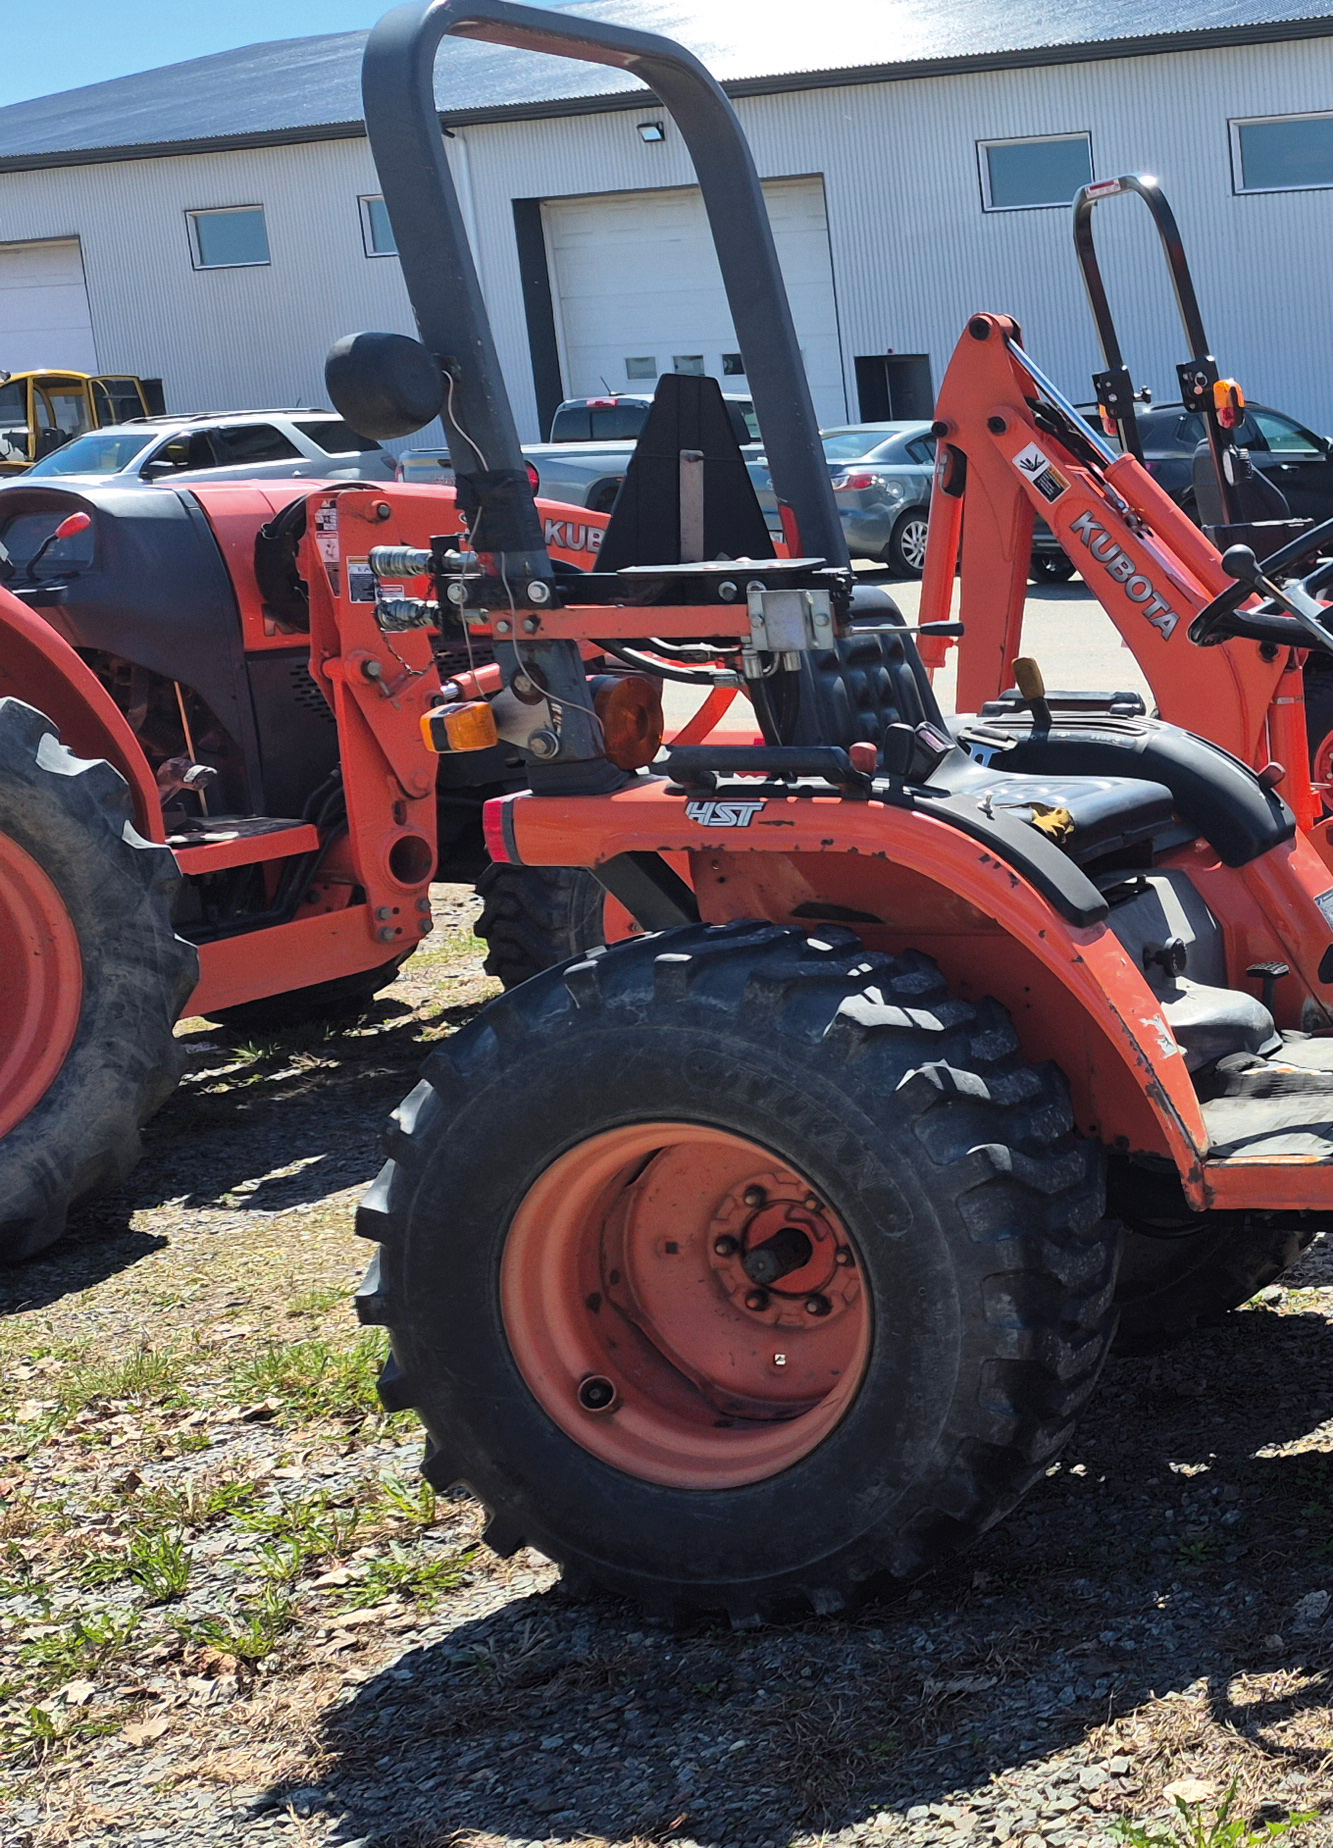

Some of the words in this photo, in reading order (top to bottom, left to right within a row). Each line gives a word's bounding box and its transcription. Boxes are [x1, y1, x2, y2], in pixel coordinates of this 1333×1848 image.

[544, 518, 606, 553] KUB
[1069, 510, 1181, 641] KUBOTA
[685, 801, 765, 828] HST
